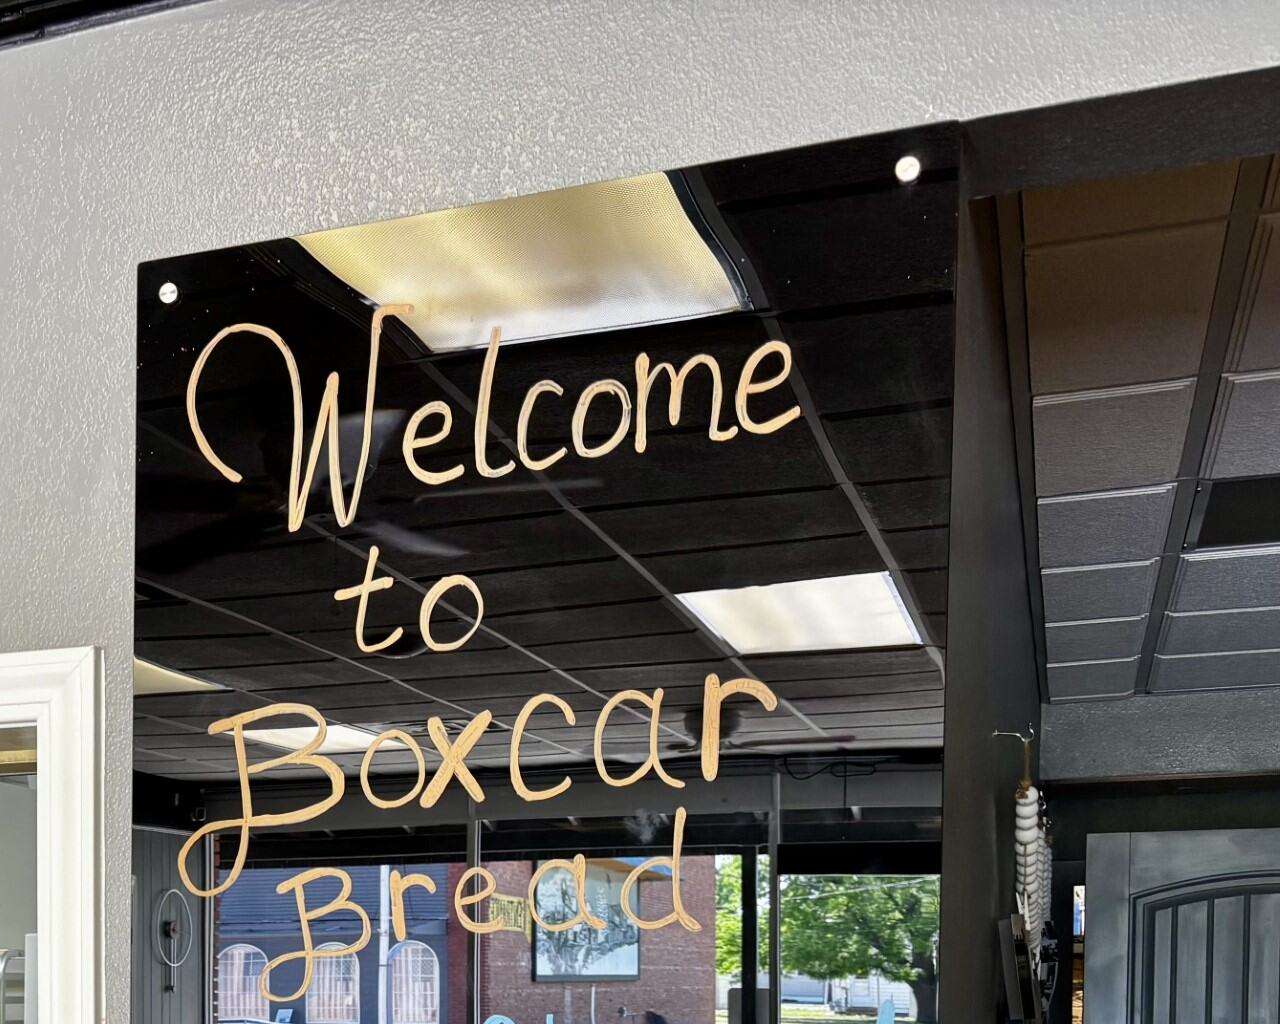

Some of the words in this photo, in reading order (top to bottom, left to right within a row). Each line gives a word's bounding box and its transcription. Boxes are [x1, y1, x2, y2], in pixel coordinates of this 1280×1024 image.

[186, 303, 802, 533] Welcome
[334, 545, 484, 653] to
[177, 673, 778, 898] Boxcar
[257, 806, 703, 1002] Bread
